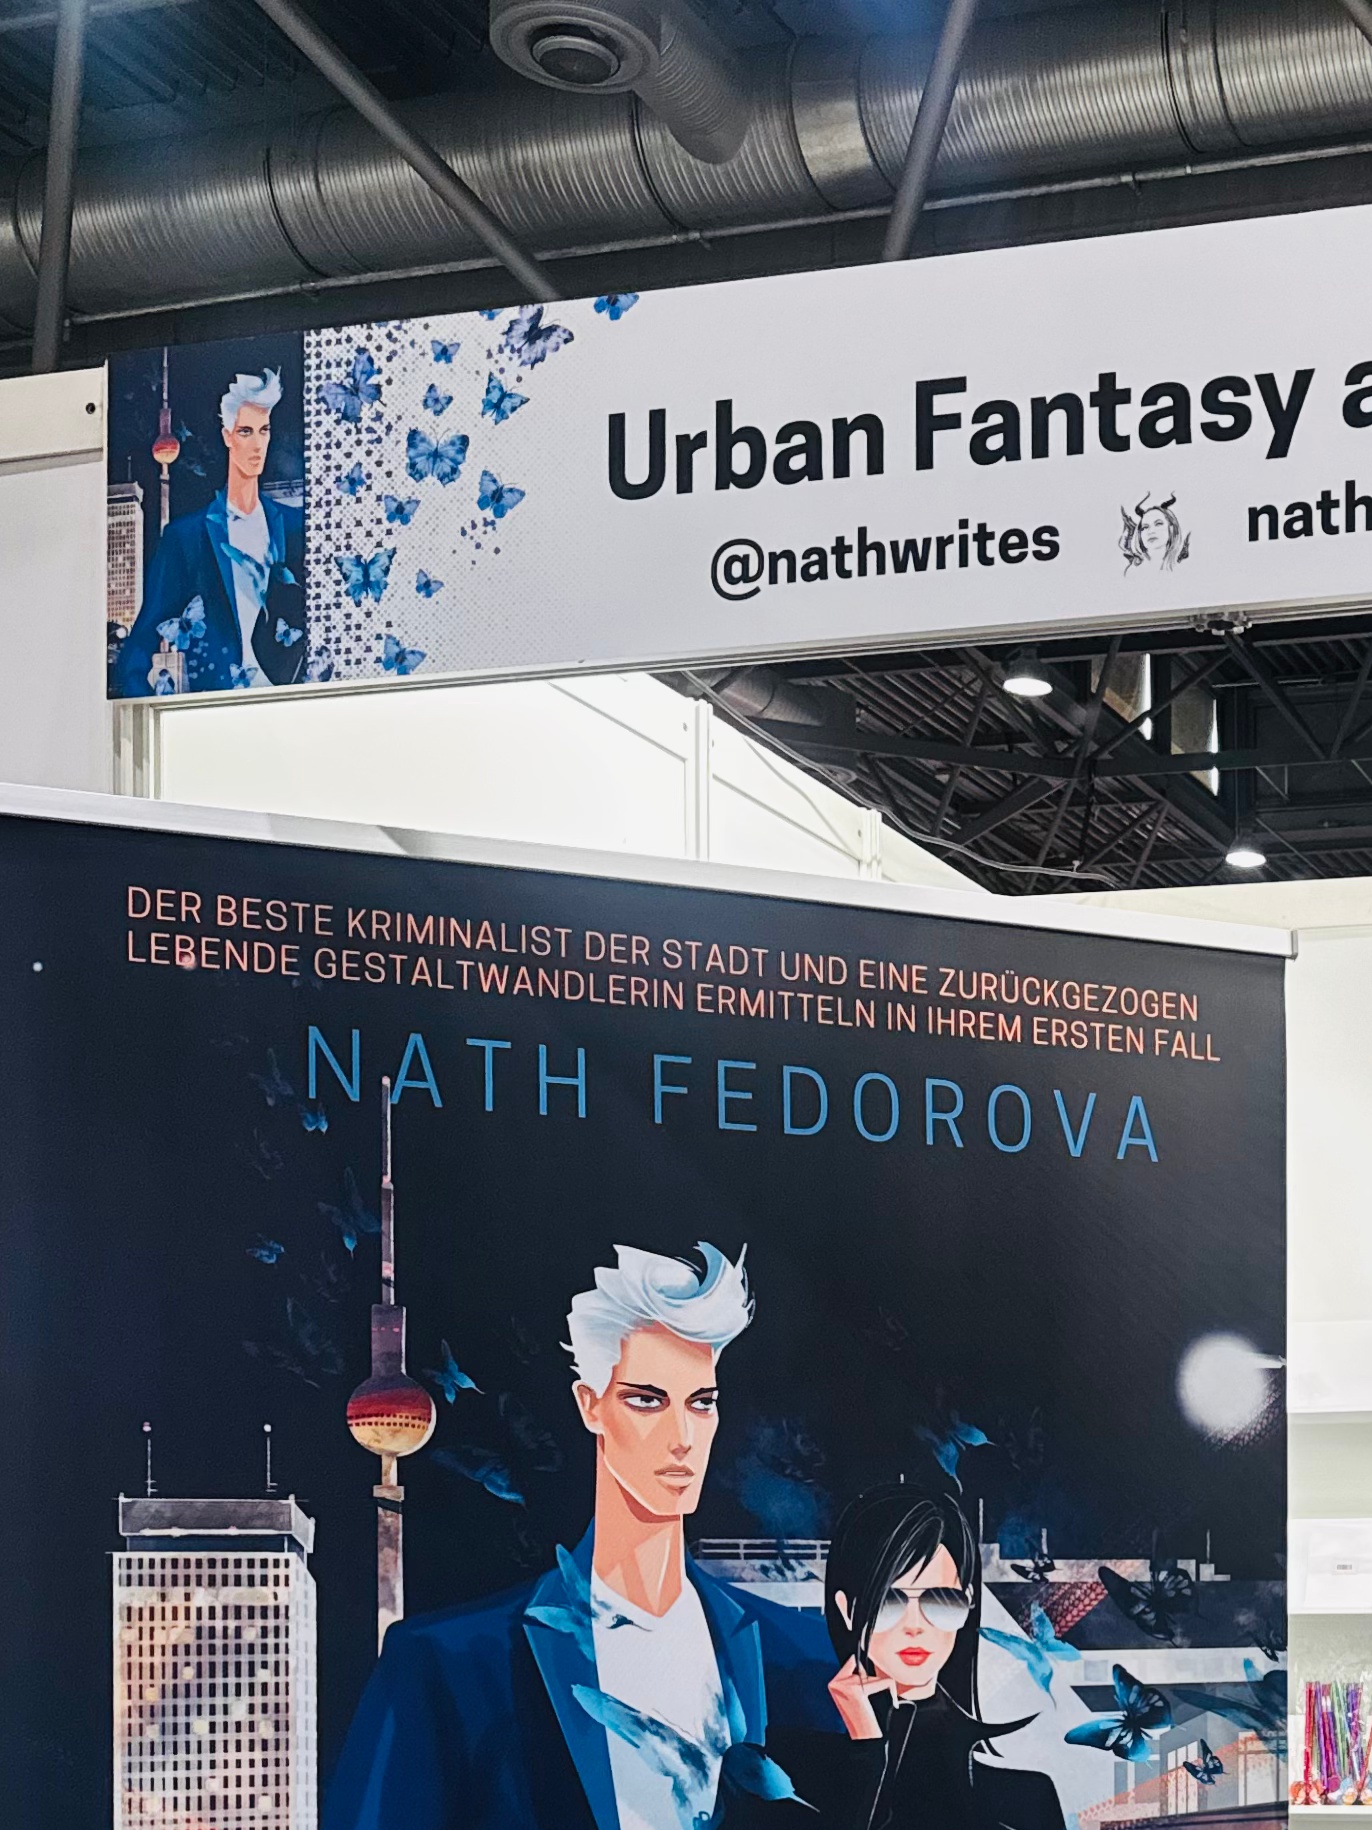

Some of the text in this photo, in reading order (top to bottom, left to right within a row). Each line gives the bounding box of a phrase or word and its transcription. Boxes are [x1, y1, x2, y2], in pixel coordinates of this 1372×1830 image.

[609, 399, 883, 500] Urban
[916, 367, 1314, 472] Fantasy
[710, 518, 1060, 601] @nathwrites
[127, 886, 1198, 1022] DER BESTE KRIMINALIST DER STADT UND EINE ZURÜCKGEZOGEN
[127, 930, 1221, 1062] LEBENDE GESTALTWANDLERIN ERMITTELN IN IHREM ERSTEN FALL
[308, 1025, 1159, 1163] NATH FEDOROVA
